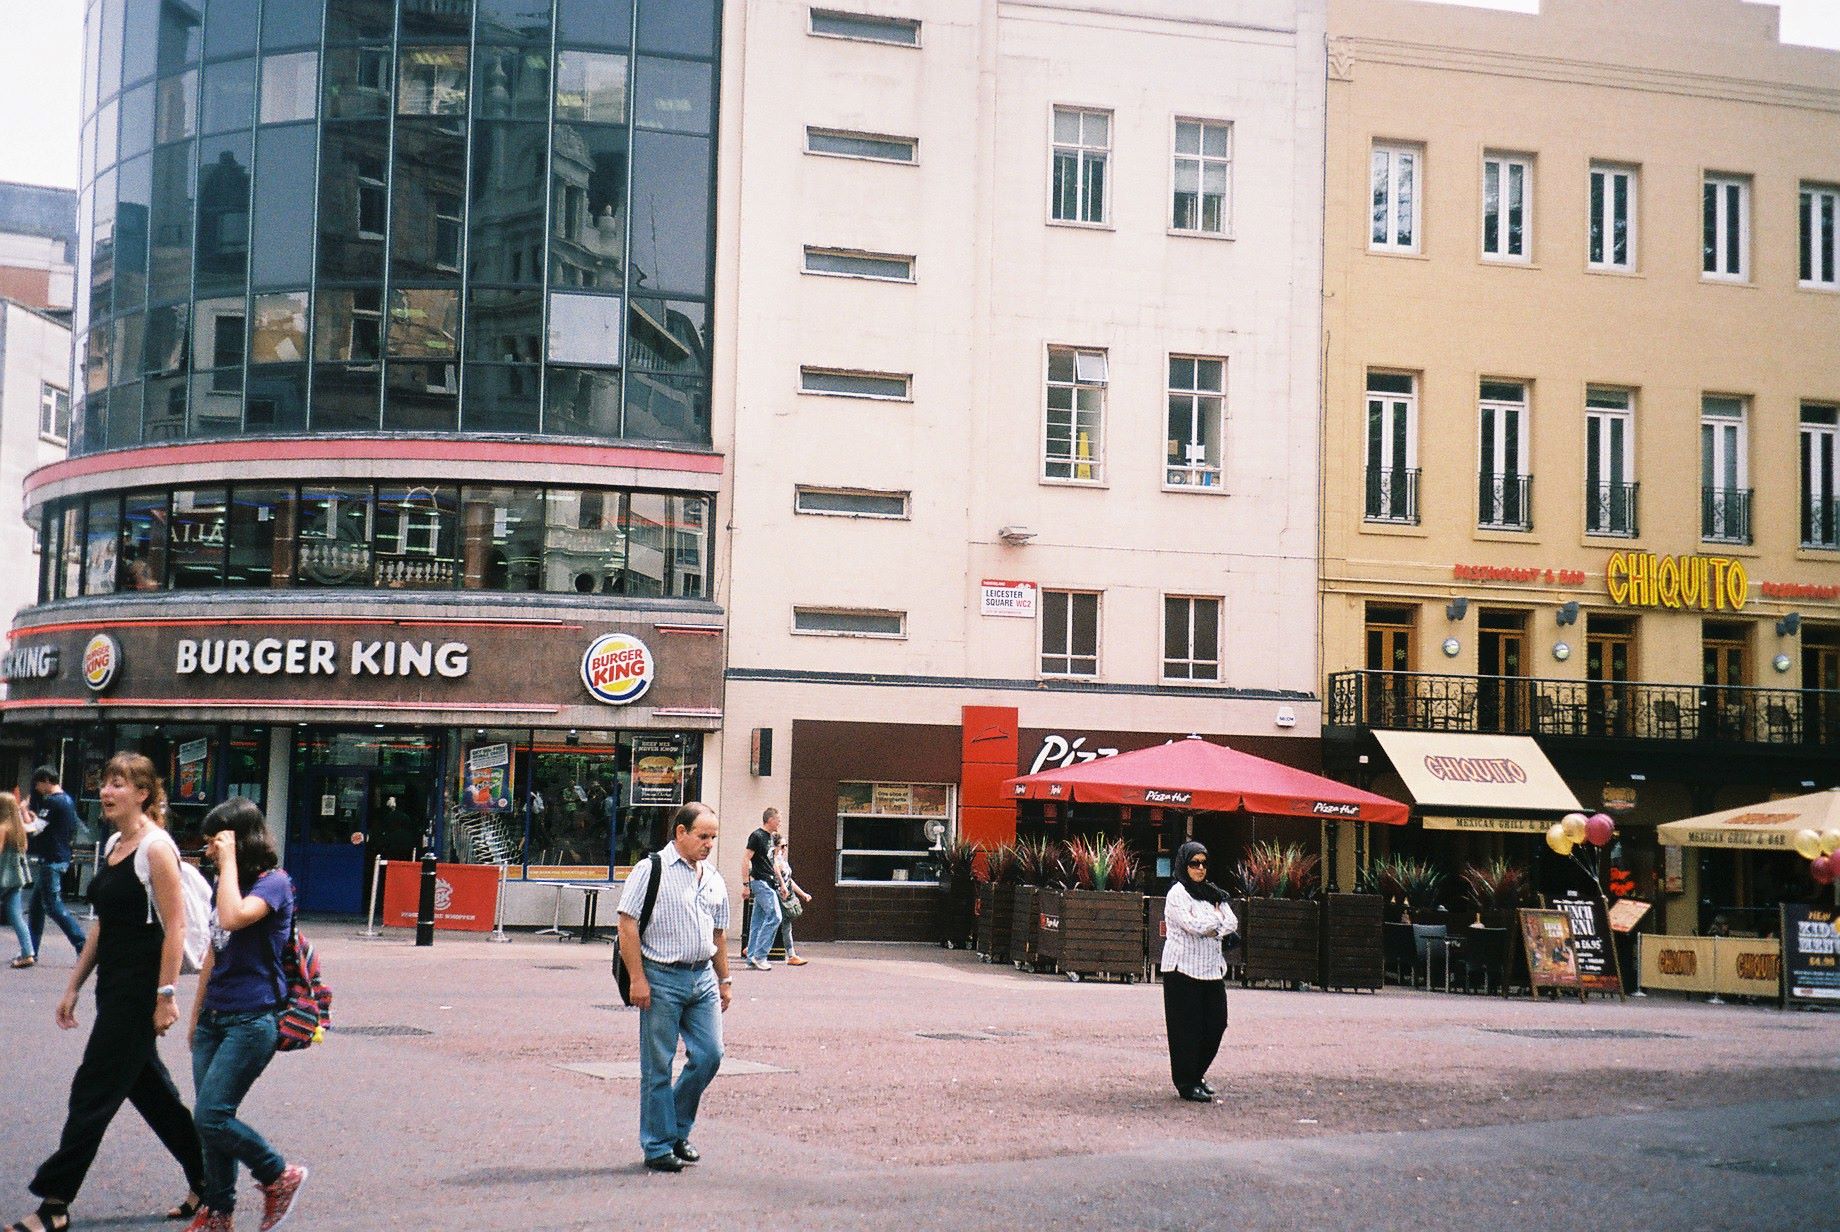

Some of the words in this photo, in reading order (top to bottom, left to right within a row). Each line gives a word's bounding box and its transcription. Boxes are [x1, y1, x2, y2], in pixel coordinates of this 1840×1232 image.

[1607, 552, 1748, 610] CHIQUITO
[986, 590, 1023, 599] LEICESTER
[986, 598, 1013, 607] SQUARE
[1015, 600, 1031, 608] WC2
[14, 645, 51, 678] KING
[85, 654, 110, 676] KING
[176, 638, 335, 674] BURGER
[351, 640, 469, 677] KING
[592, 649, 643, 670] BURGER
[593, 660, 645, 687] KING
[1424, 755, 1527, 783] CHIQUITO
[1145, 790, 1171, 801] Pizza
[1171, 792, 1191, 802] Hut
[1313, 802, 1340, 813] Pizza
[1340, 804, 1359, 815] Hut
[1456, 818, 1494, 829] MEXICAN
[1500, 819, 1523, 829] GRILL
[1571, 920, 1595, 935] ENU
